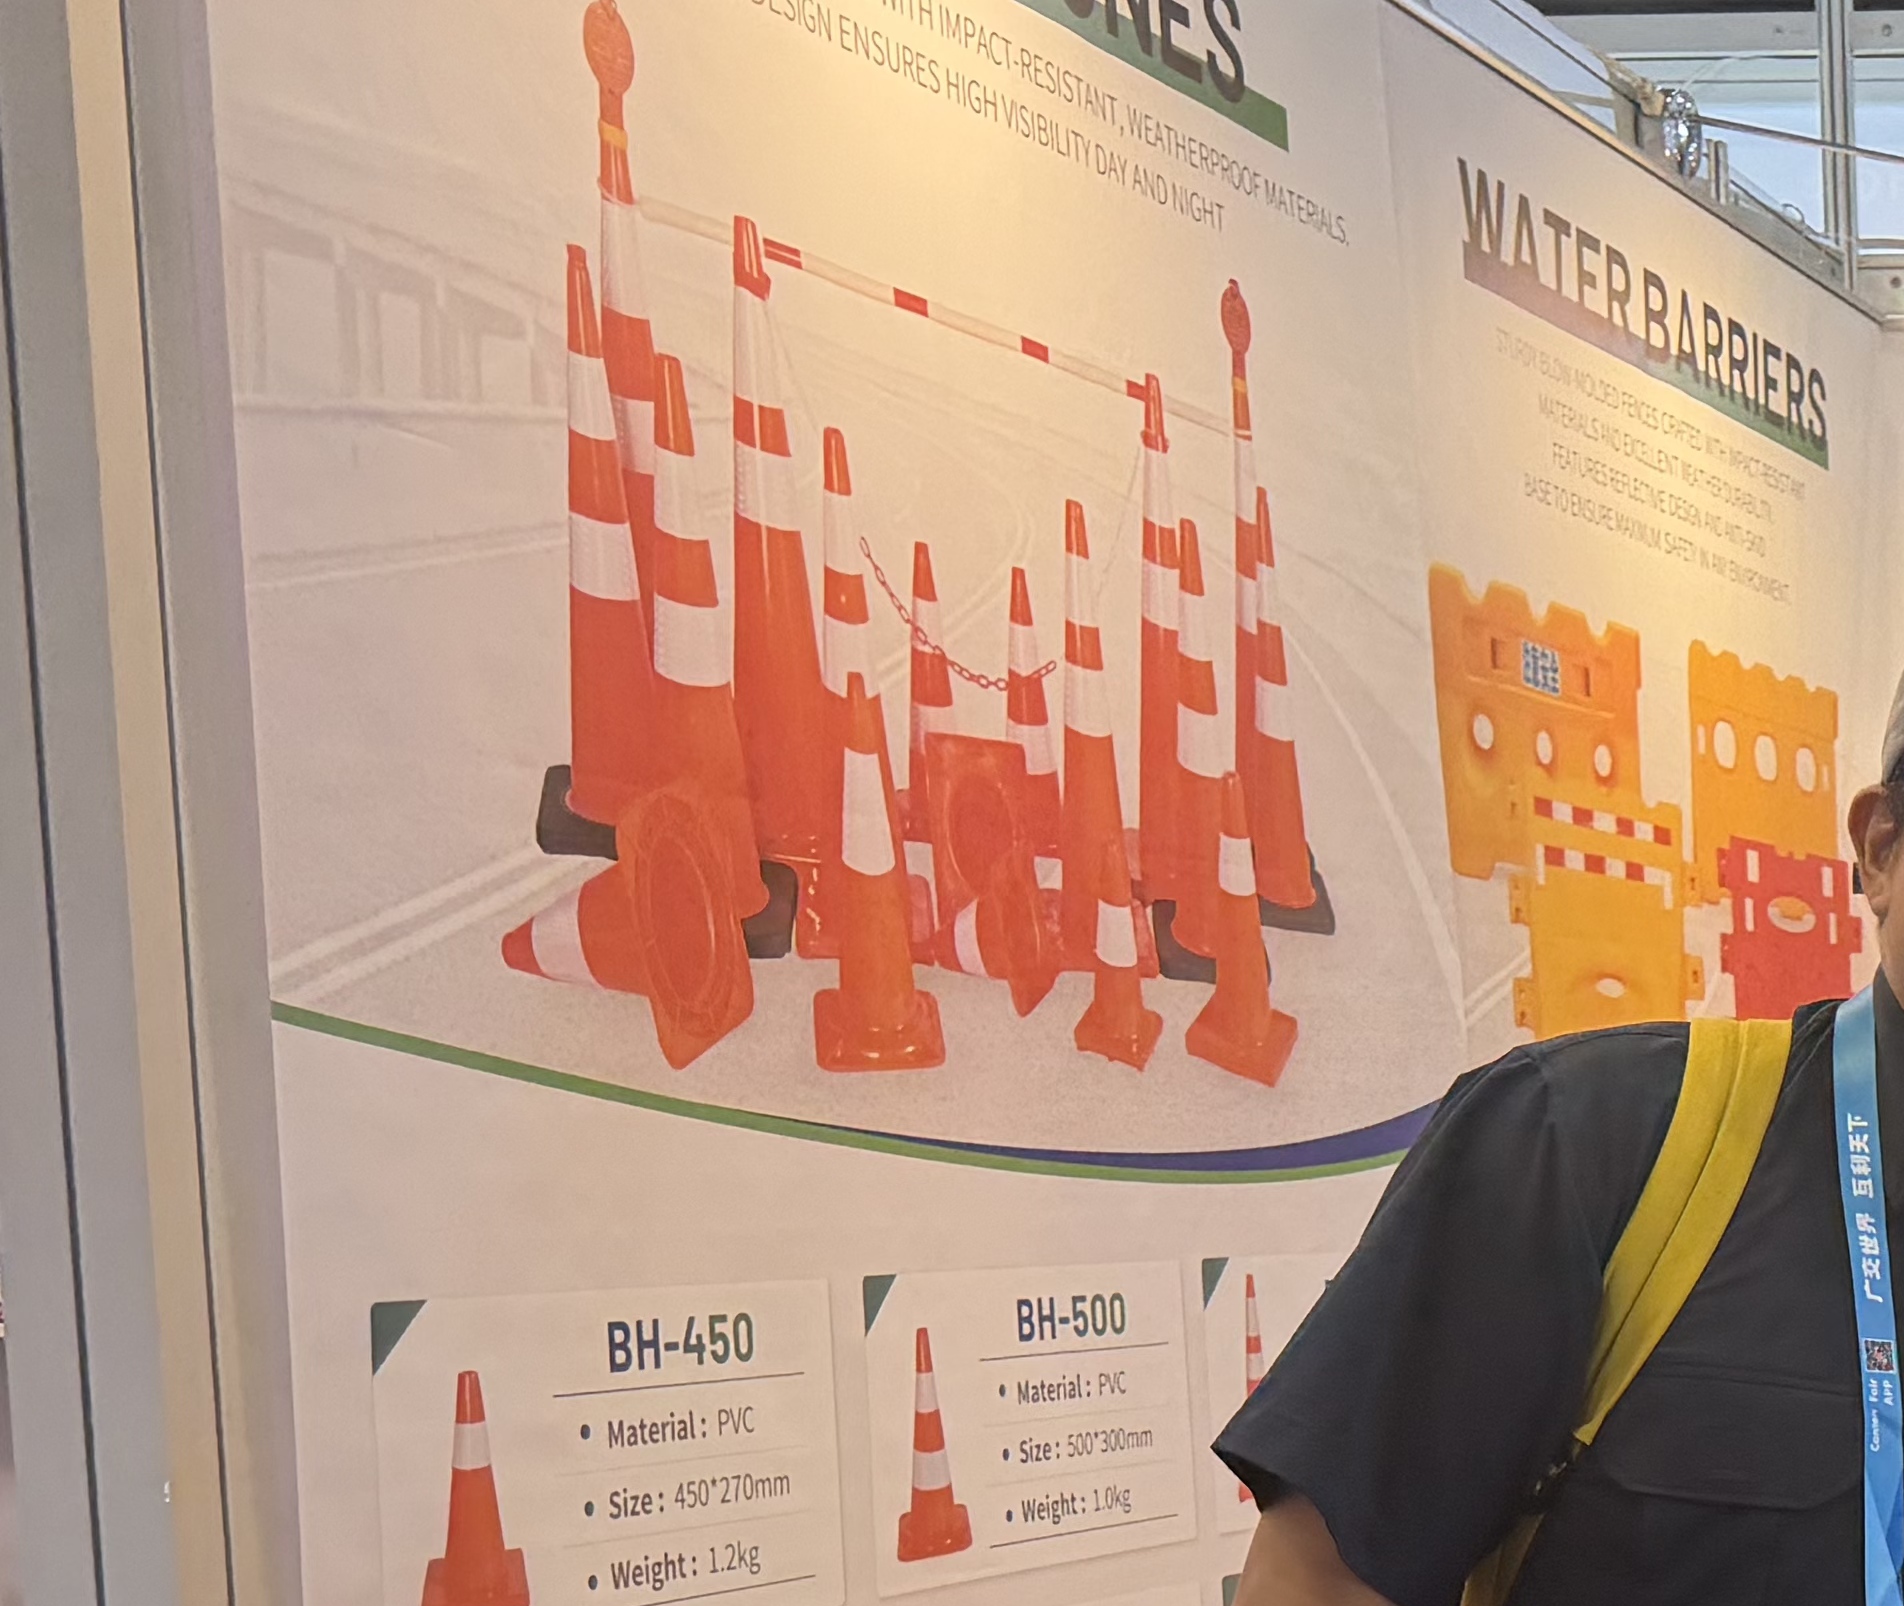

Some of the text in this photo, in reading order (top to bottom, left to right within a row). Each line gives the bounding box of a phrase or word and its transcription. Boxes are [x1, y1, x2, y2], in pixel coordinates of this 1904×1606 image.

[839, 14, 1225, 233] ENSURES HIGH VISIBILITY DAY AND NIGHT
[1127, 104, 1350, 246] WEATHERPROOF MATERIALS.
[1458, 156, 1828, 449] WATER BARRIERS
[1552, 442, 1608, 487] FEATURES
[1624, 433, 1679, 477] EXCELLENT
[1524, 473, 1552, 506] BASE
[1554, 486, 1569, 512] TO
[1571, 492, 1614, 532] ENSURE
[1615, 511, 1661, 551] MAXIMUM
[1846, 1112, 1884, 1304] 广交世界 互利天下
[1016, 1292, 1127, 1342] BH-500
[607, 1312, 755, 1374] BH-450
[1099, 1371, 1127, 1397] PVC
[1882, 1379, 1896, 1406] APP
[717, 1406, 756, 1437] PVC
[1093, 1485, 1132, 1514] 1.0kg
[708, 1540, 762, 1575] 1.2kg
